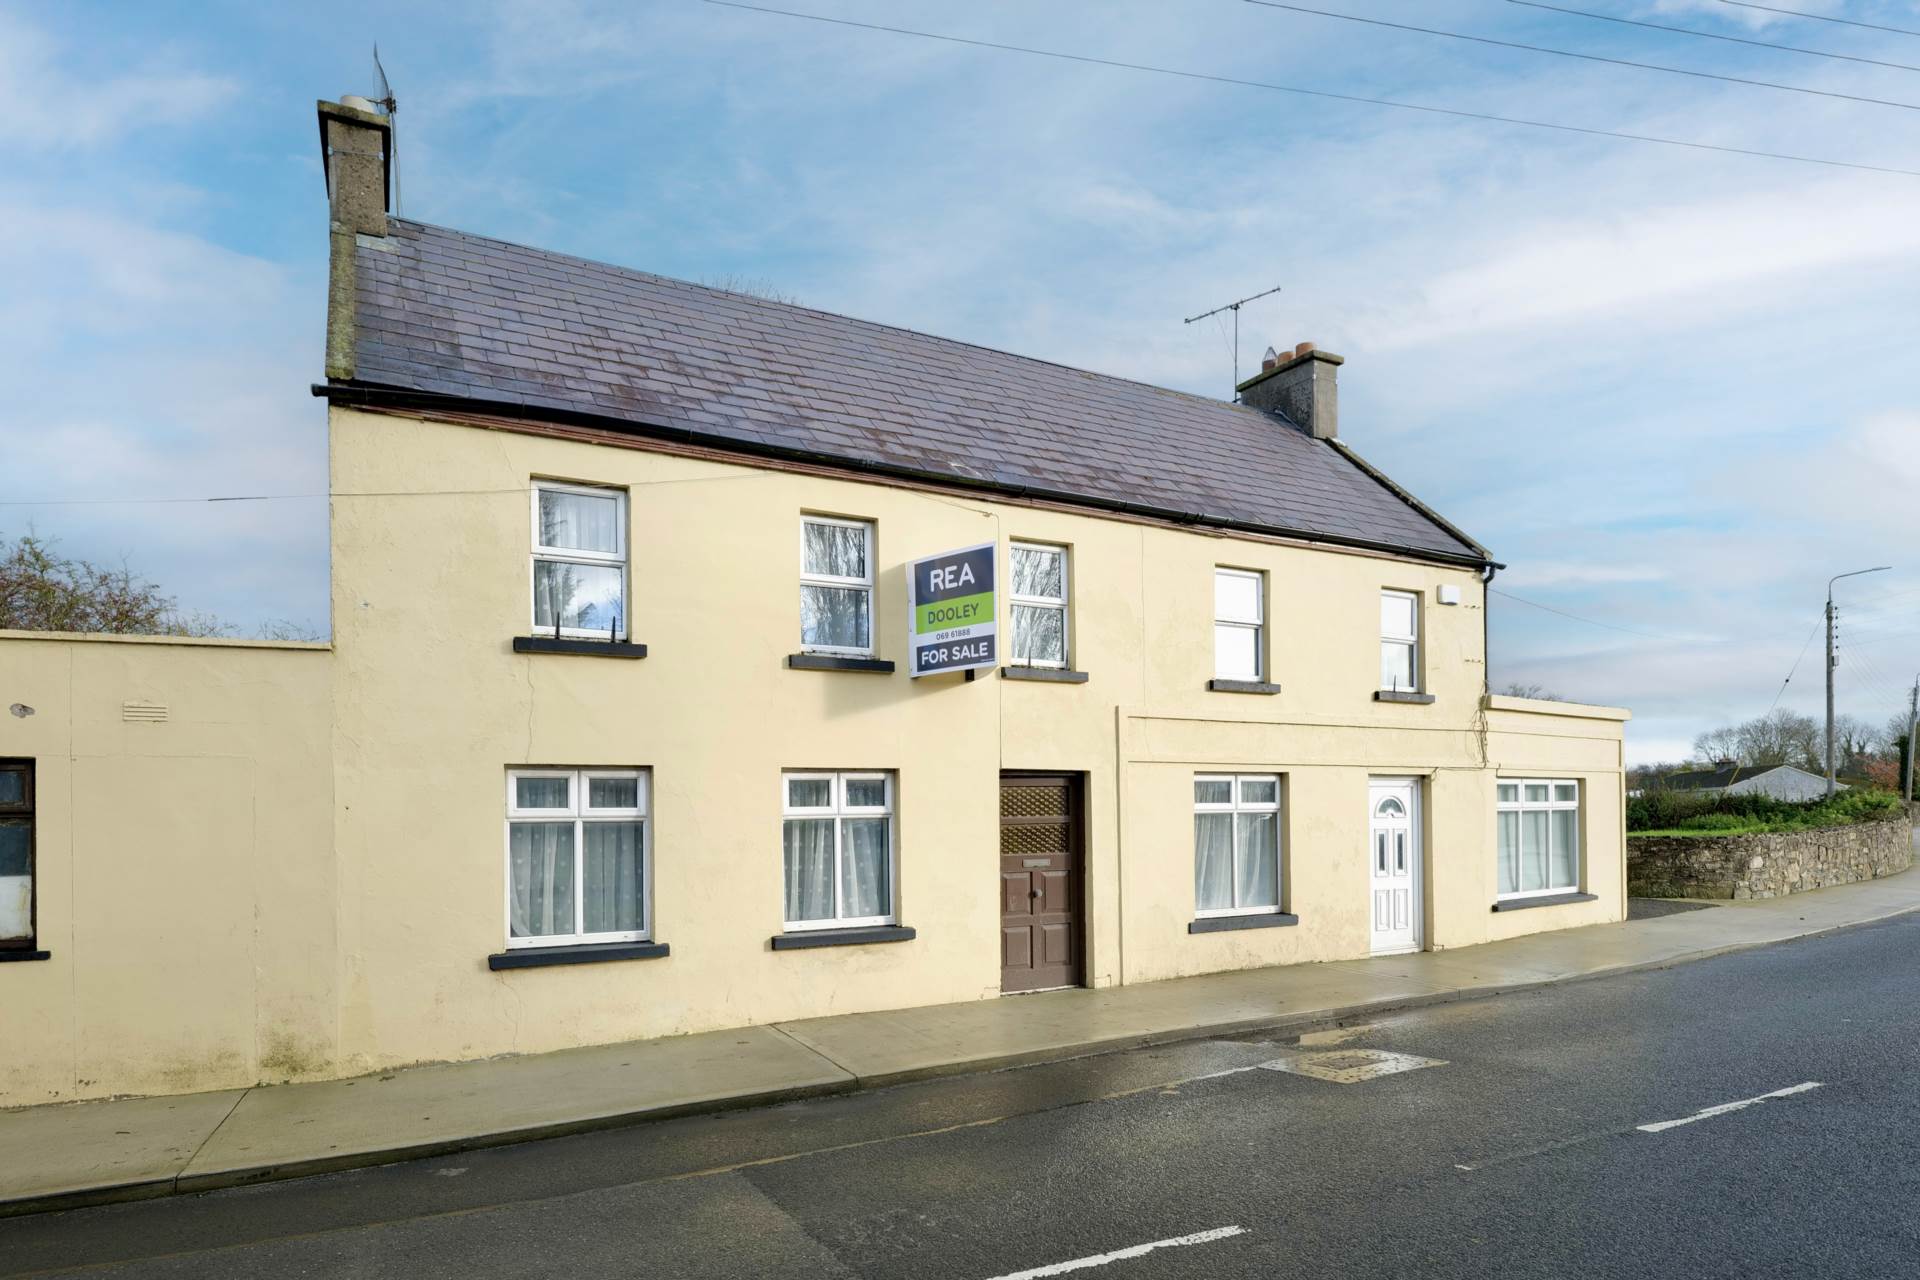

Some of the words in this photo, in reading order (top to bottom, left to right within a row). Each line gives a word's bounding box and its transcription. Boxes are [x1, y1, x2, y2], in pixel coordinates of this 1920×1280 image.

[930, 562, 975, 592] REA
[928, 603, 979, 624] DOOLEY
[936, 630, 949, 641] 069
[921, 648, 948, 665] FOR
[952, 642, 988, 660] SALE
